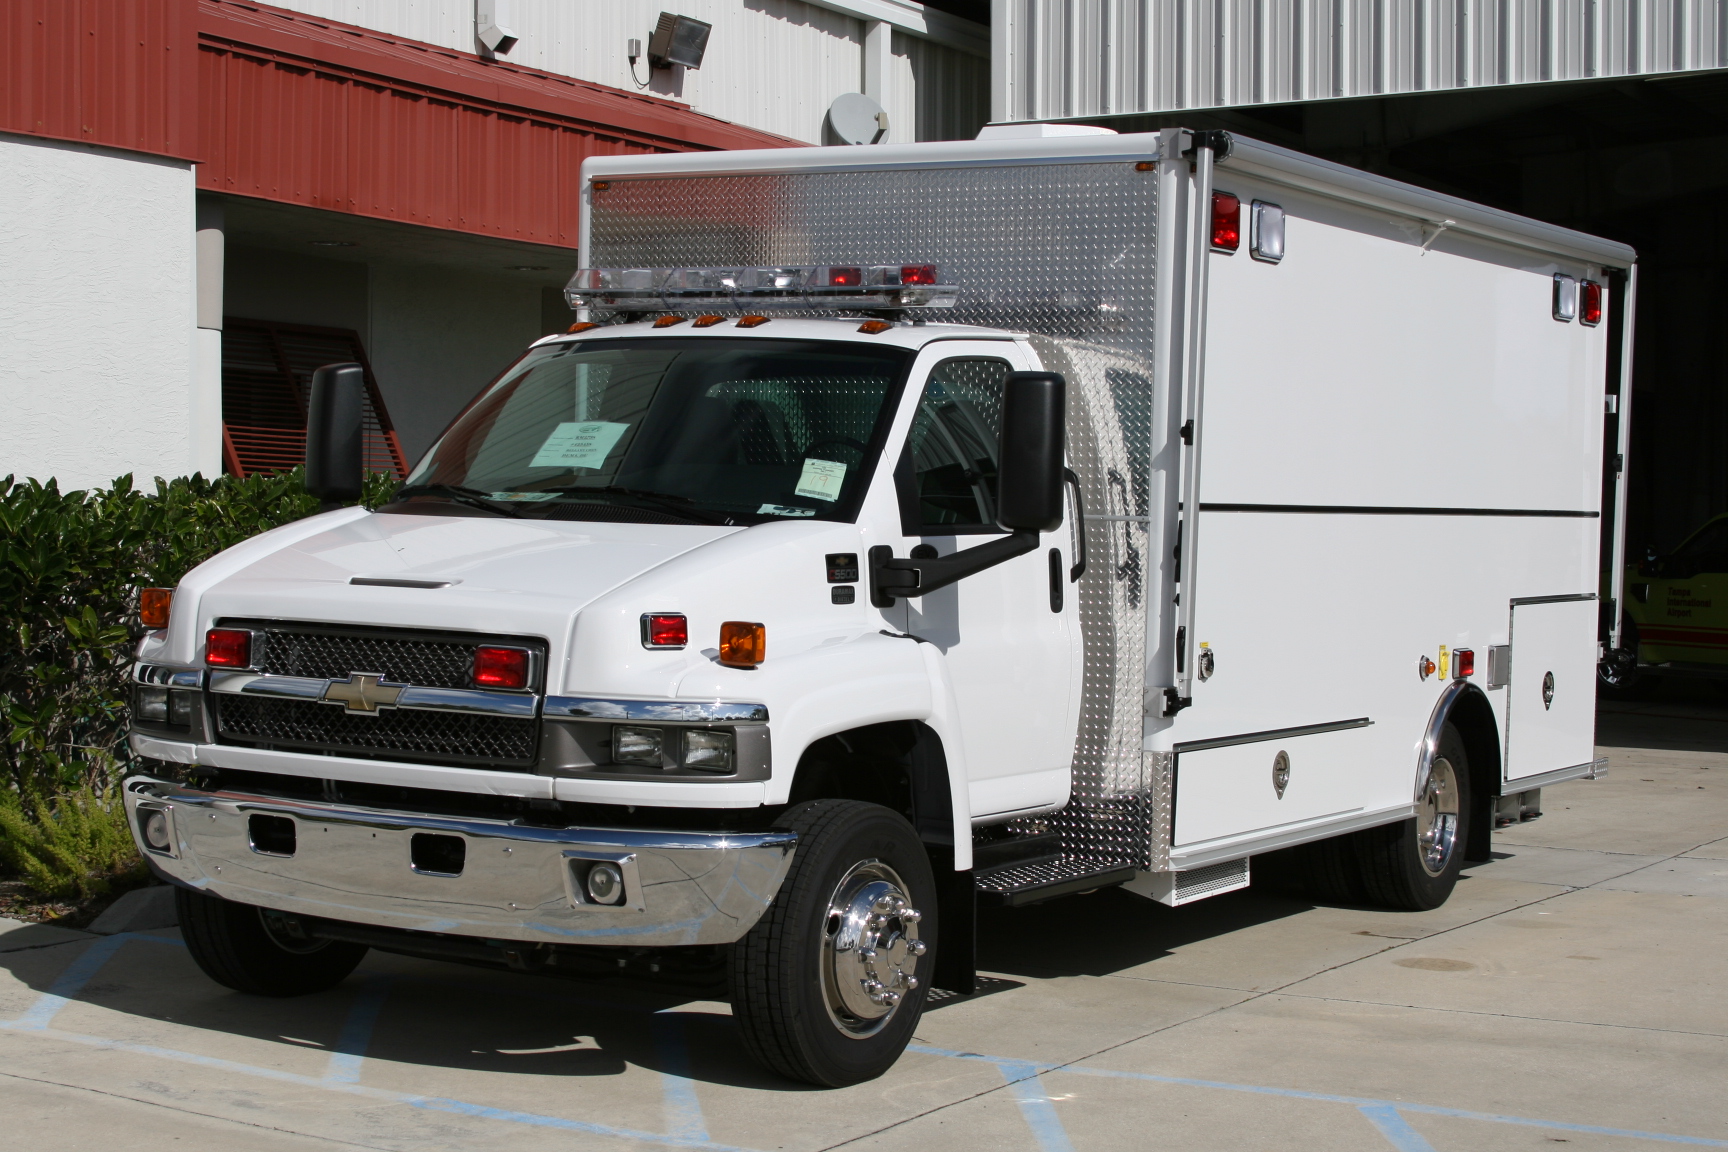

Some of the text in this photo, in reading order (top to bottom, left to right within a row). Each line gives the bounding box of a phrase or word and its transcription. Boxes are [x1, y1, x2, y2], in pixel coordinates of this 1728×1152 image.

[829, 569, 857, 580] C5500
[1668, 587, 1691, 597] Tampa
[1667, 597, 1711, 607] International
[1667, 608, 1692, 618] Airport
